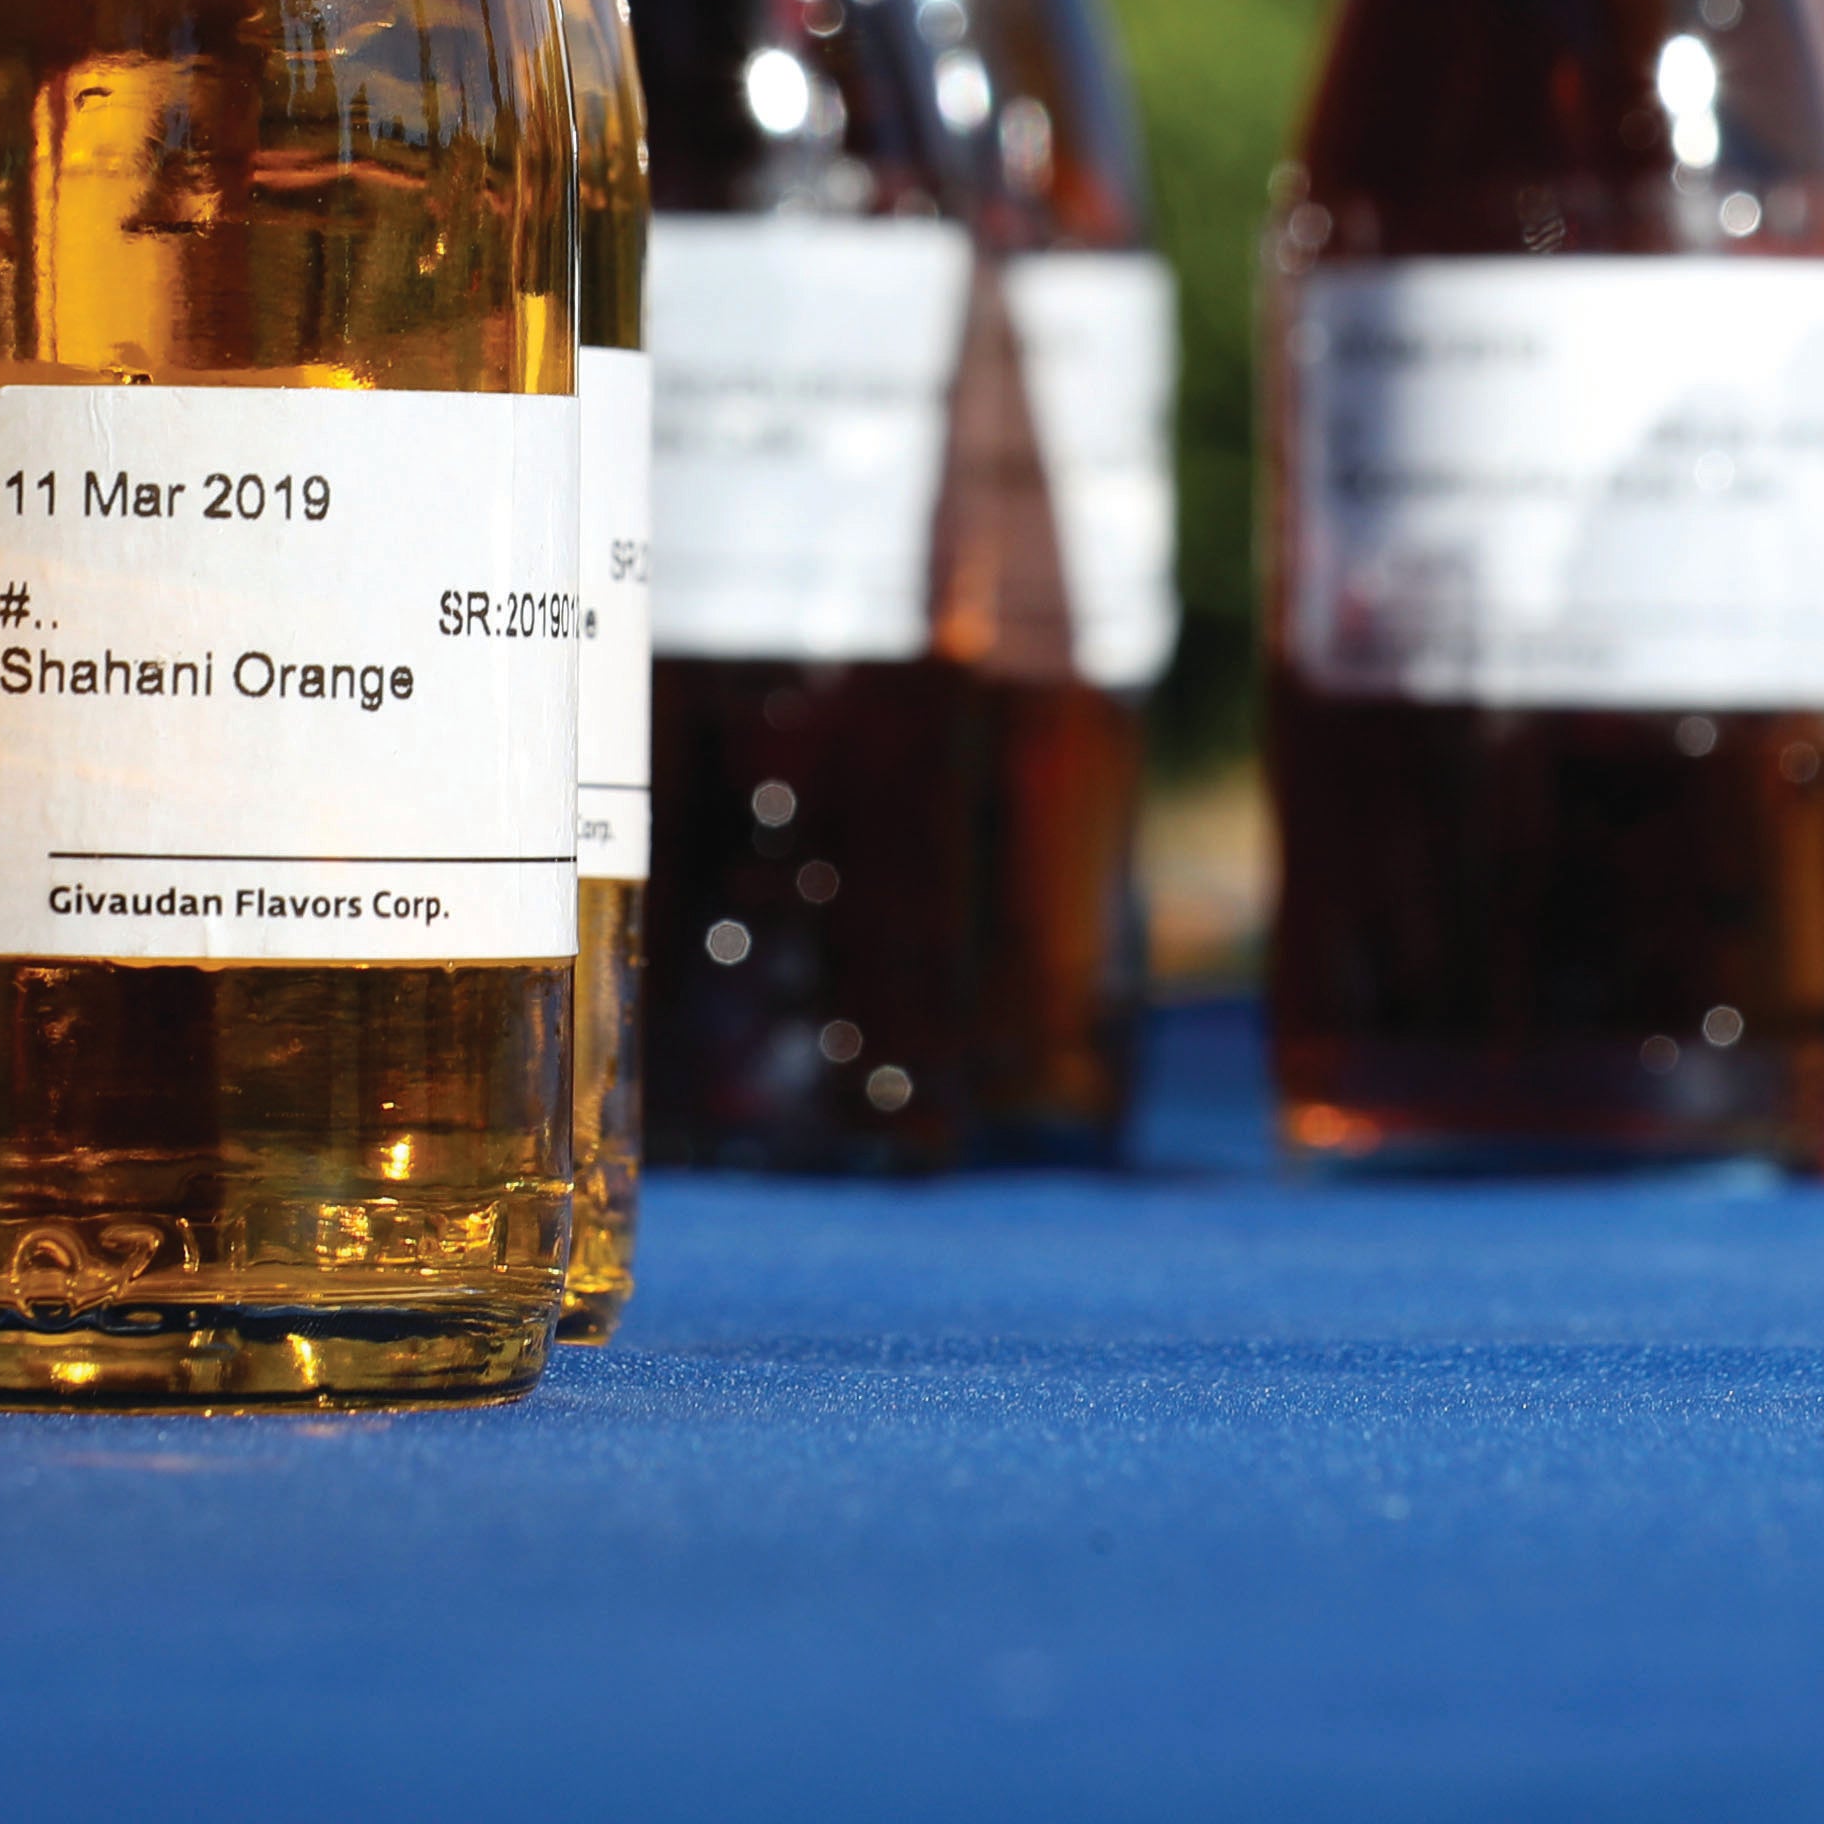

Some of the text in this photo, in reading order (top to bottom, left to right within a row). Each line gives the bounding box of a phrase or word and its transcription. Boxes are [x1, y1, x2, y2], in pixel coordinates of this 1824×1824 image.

[4, 469, 332, 522] 11 Mar 2019
[231, 649, 415, 714] Orange
[47, 882, 451, 928] Givaudan Flavors Corp.
